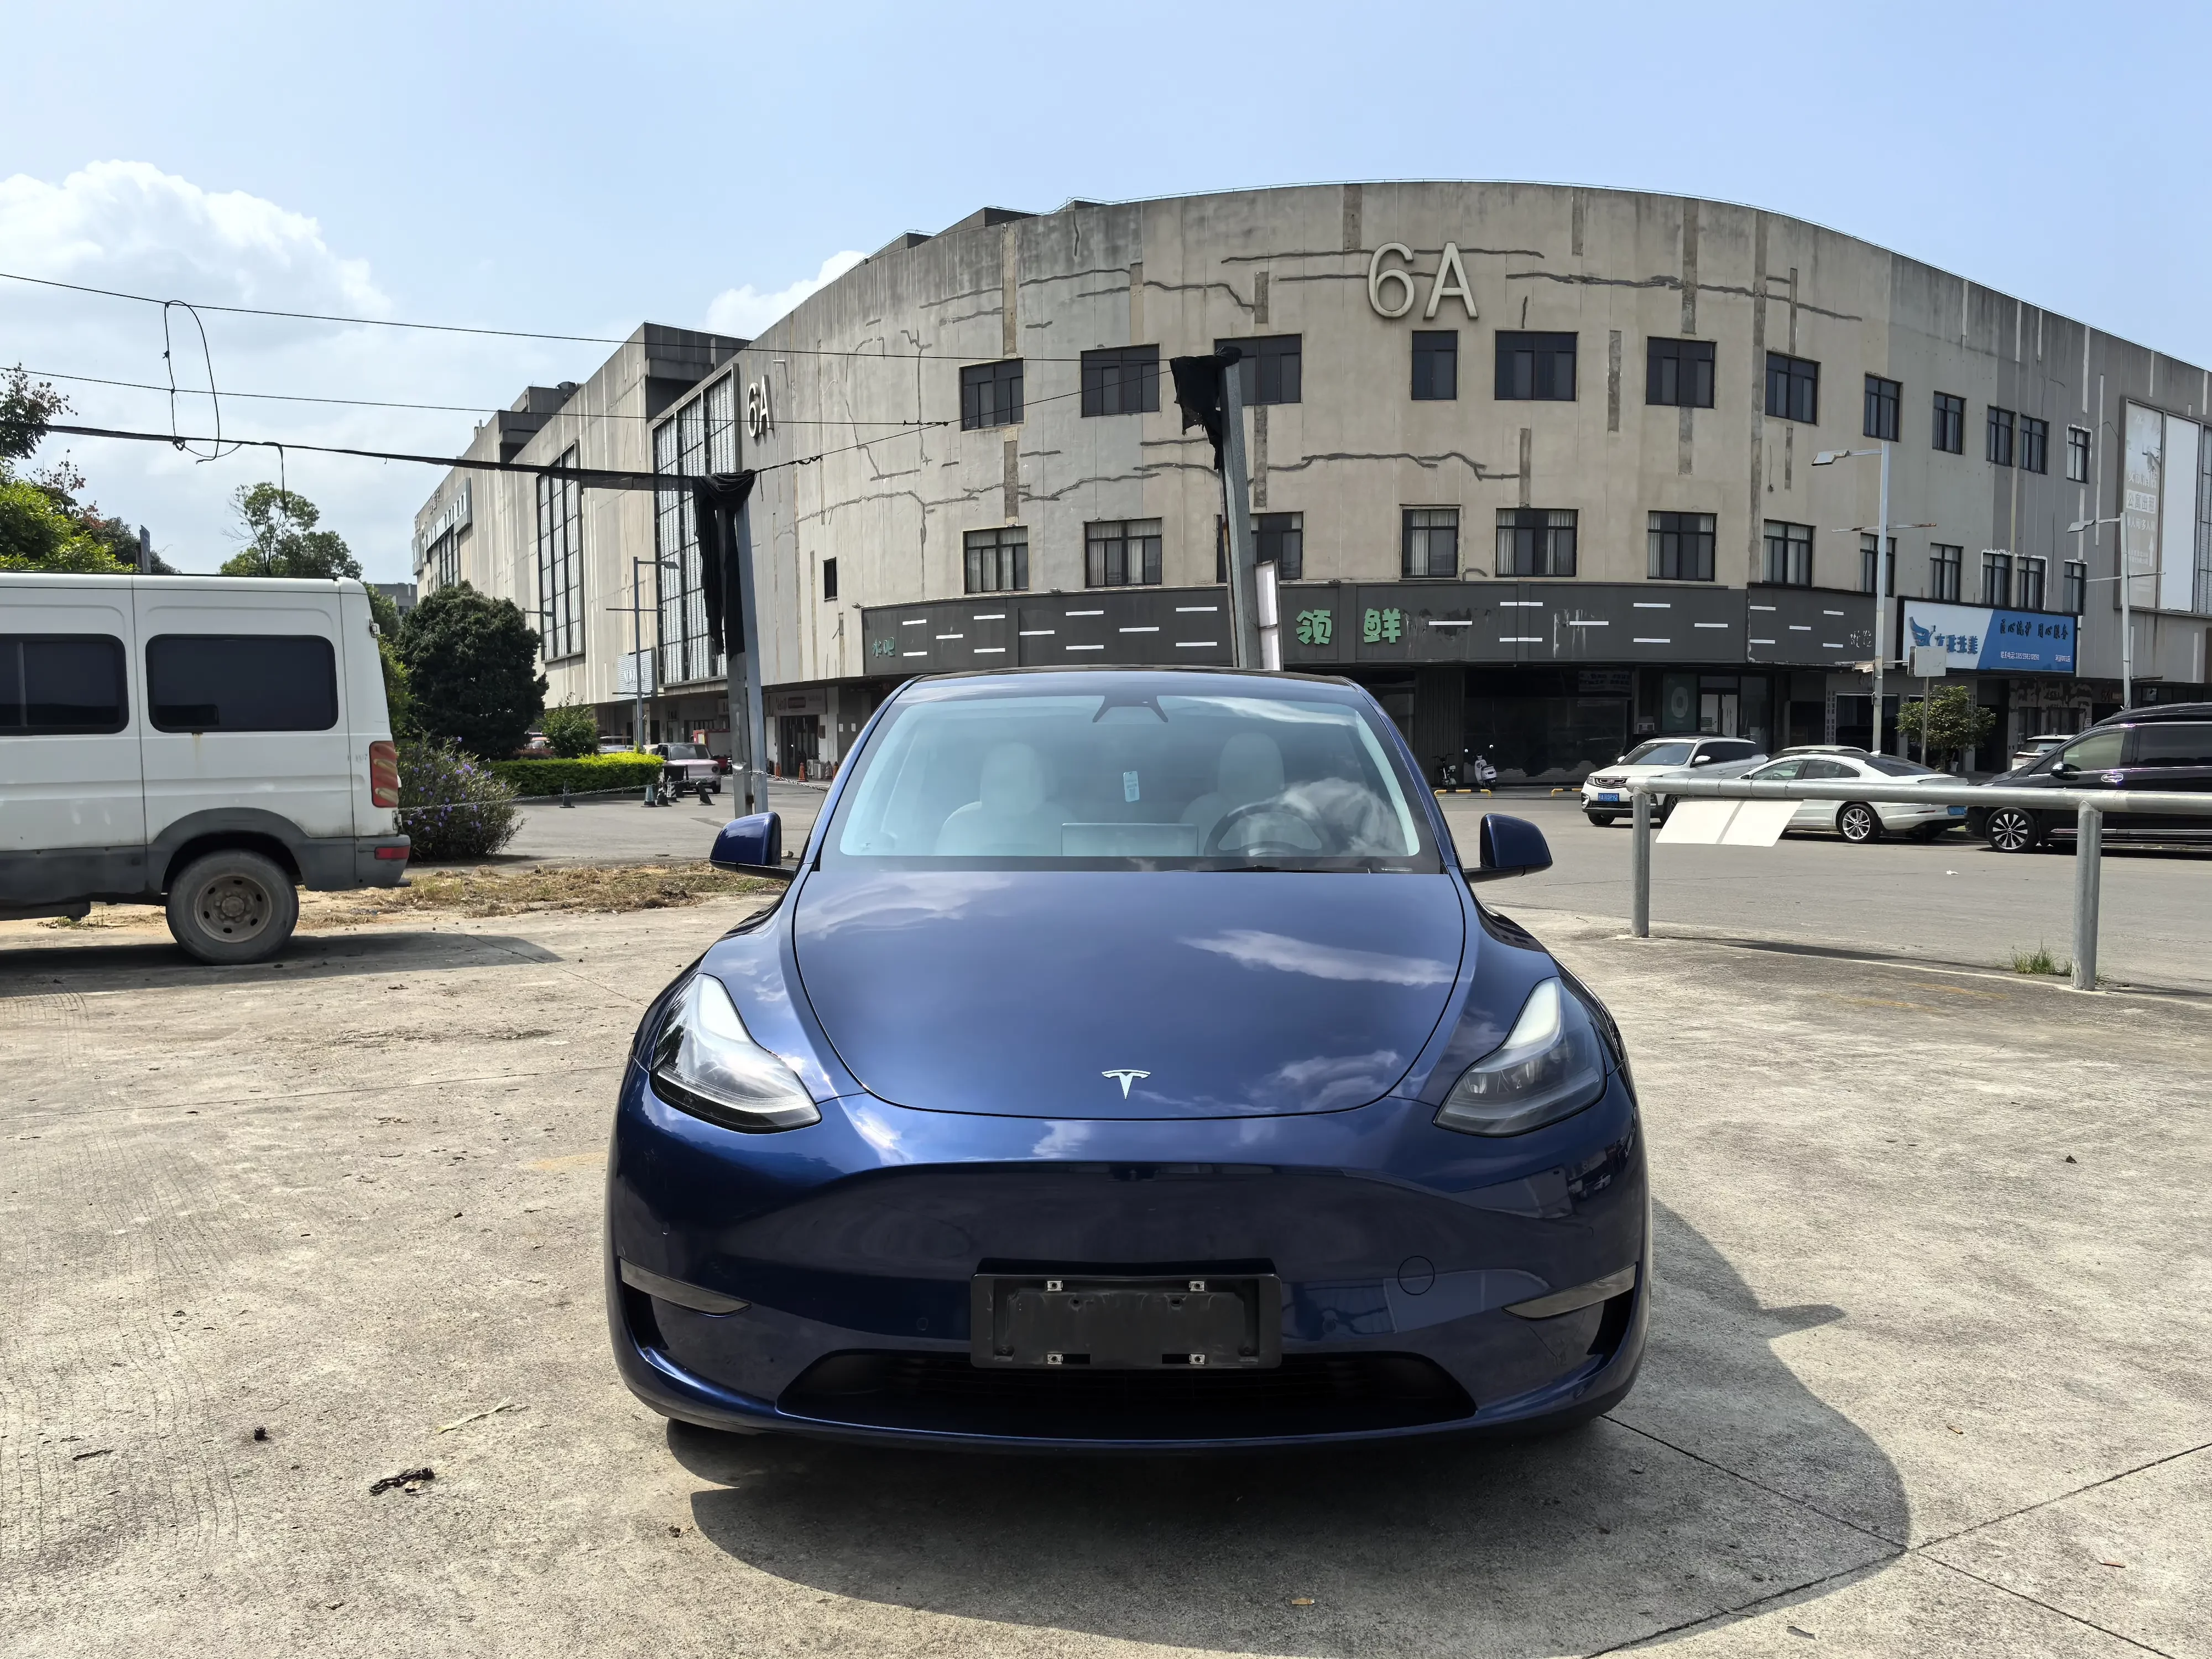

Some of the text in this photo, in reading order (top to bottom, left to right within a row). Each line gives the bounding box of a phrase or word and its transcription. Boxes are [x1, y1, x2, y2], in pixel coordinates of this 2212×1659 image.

[1368, 242, 1479, 319] 6A
[748, 374, 774, 438] 6A
[1296, 607, 1401, 645] 领鲜
